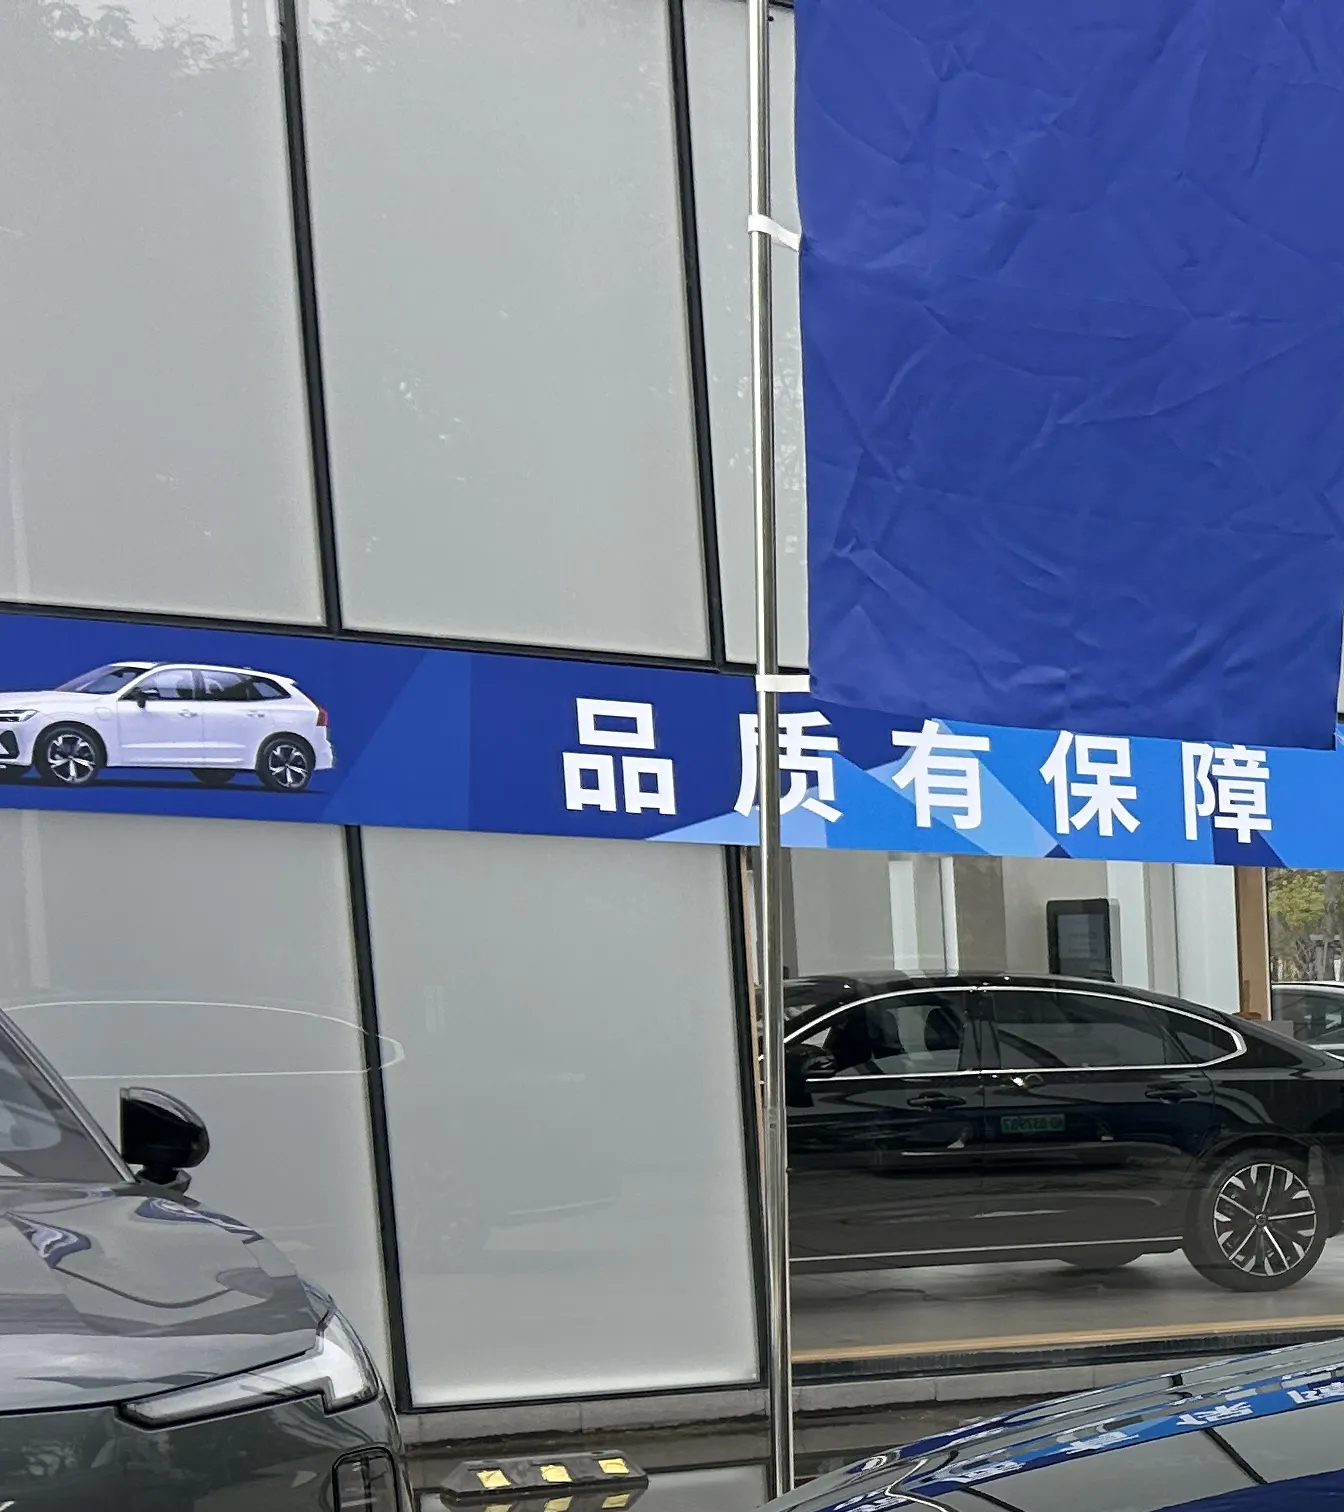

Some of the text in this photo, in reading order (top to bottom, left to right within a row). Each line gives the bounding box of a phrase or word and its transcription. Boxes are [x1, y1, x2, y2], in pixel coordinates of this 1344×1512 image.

[562, 697, 1273, 844] 品质有保障
